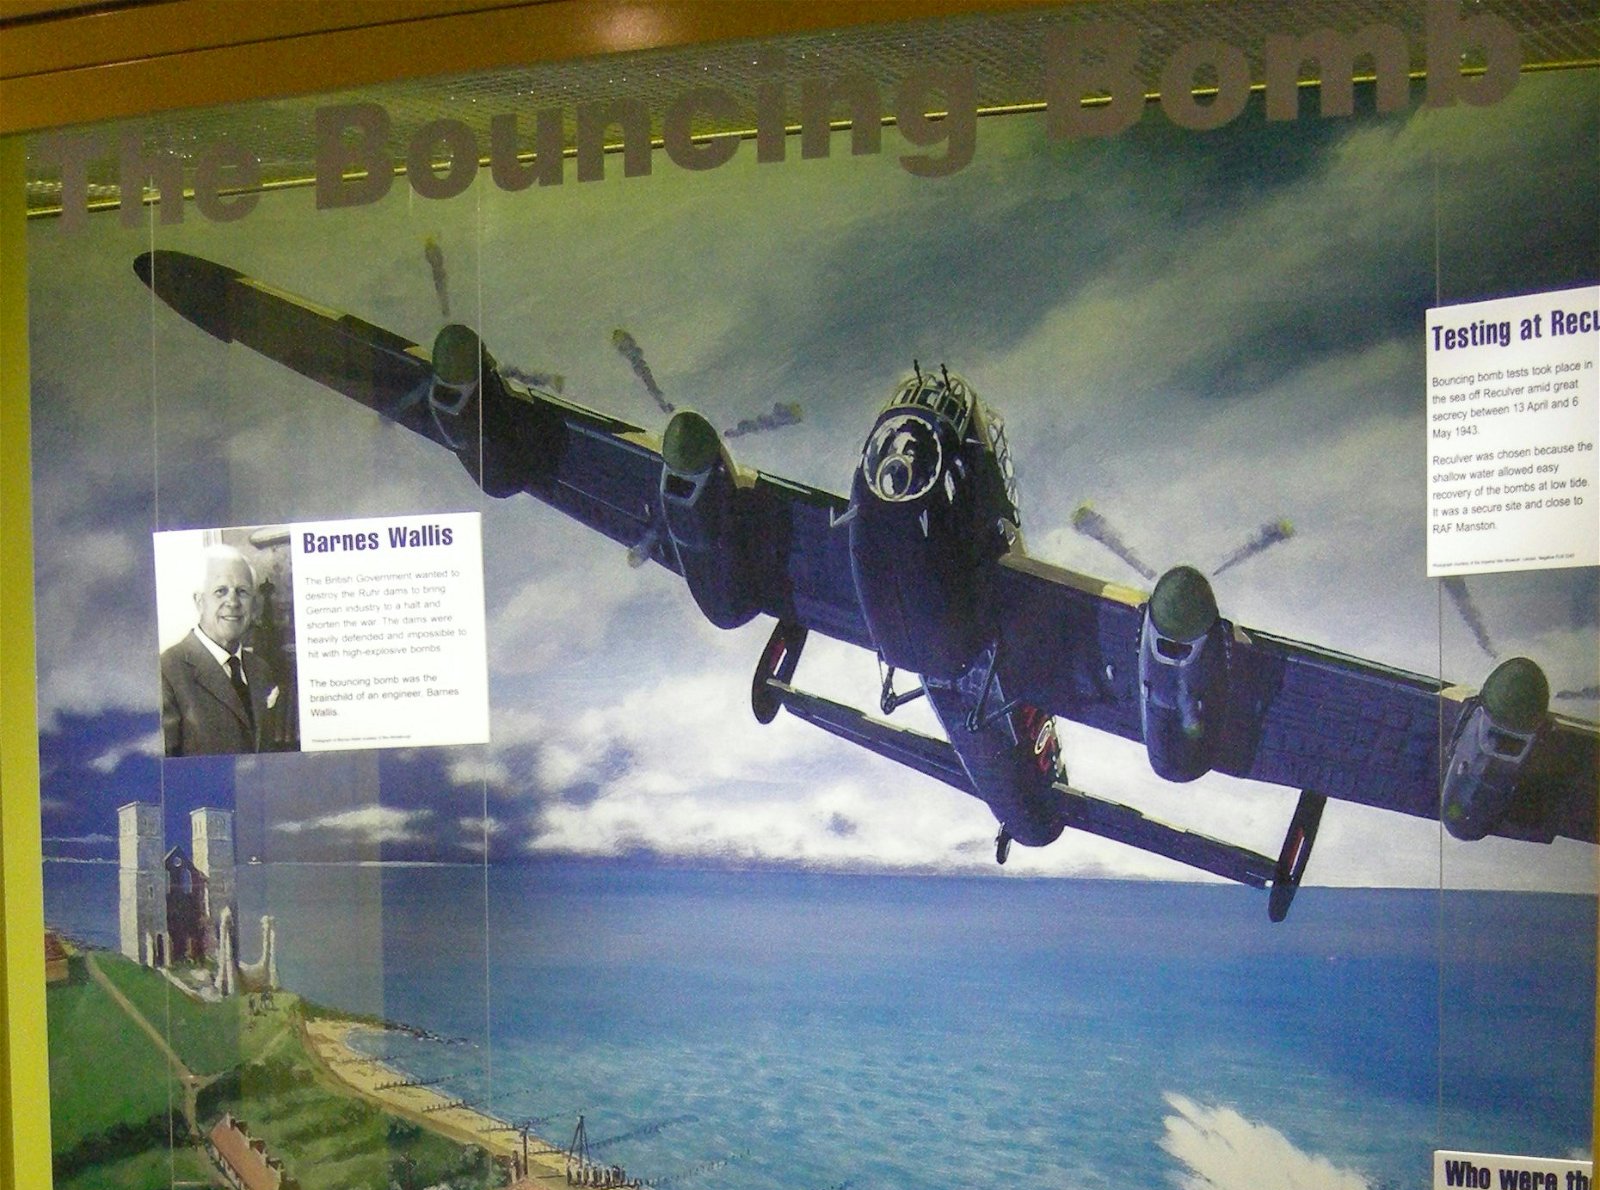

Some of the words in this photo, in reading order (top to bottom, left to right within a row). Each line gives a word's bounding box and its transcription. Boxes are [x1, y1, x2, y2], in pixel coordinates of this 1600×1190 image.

[39, 125, 261, 237] The
[315, 50, 977, 210] Bouncing
[1046, 0, 1522, 139] Bomb
[1432, 320, 1511, 351] Testing
[1521, 314, 1541, 340] at
[1432, 375, 1474, 387] Bouncing
[1478, 371, 1503, 382] bomb
[1507, 368, 1529, 378] tests
[1532, 364, 1551, 375] took
[1555, 363, 1581, 375] place
[1584, 361, 1592, 369] in
[1432, 395, 1446, 404] the
[1450, 394, 1466, 402] sea
[1469, 389, 1480, 400] off
[1484, 387, 1524, 398] Reculver
[1528, 382, 1550, 394] amid
[1554, 380, 1578, 393] great
[1433, 411, 1467, 421] secrecy
[1471, 406, 1509, 417] between
[1514, 402, 1524, 412] 13
[1527, 400, 1548, 412] April
[1551, 398, 1569, 409] and
[1572, 396, 1578, 406] 6
[1433, 429, 1451, 440] May
[1433, 455, 1472, 465] Reculver
[1476, 452, 1494, 461] was
[1497, 449, 1531, 459] chosen
[1534, 445, 1574, 456] because
[1578, 442, 1593, 451] the
[1433, 472, 1466, 483] shallow
[1470, 470, 1494, 478] water
[1498, 464, 1533, 476] allowed
[1536, 464, 1559, 474] easy
[1433, 490, 1471, 500] recovery
[1475, 486, 1483, 496] of
[1486, 486, 1500, 495] the
[1504, 483, 1535, 493] bombs
[1539, 481, 1547, 490] at
[1551, 480, 1566, 489] low
[1442, 508, 1459, 516] was
[1472, 504, 1502, 513] secure
[1506, 502, 1521, 511] site
[1525, 499, 1542, 509] and
[1546, 498, 1570, 507] close
[1574, 496, 1583, 505] to
[303, 533, 379, 553] Barnes
[389, 525, 452, 548] Wallis
[1433, 523, 1452, 533] RAF
[310, 679, 326, 687] The
[330, 679, 370, 687] bouncing
[374, 676, 399, 684] bomb
[1446, 1161, 1491, 1189] Who
